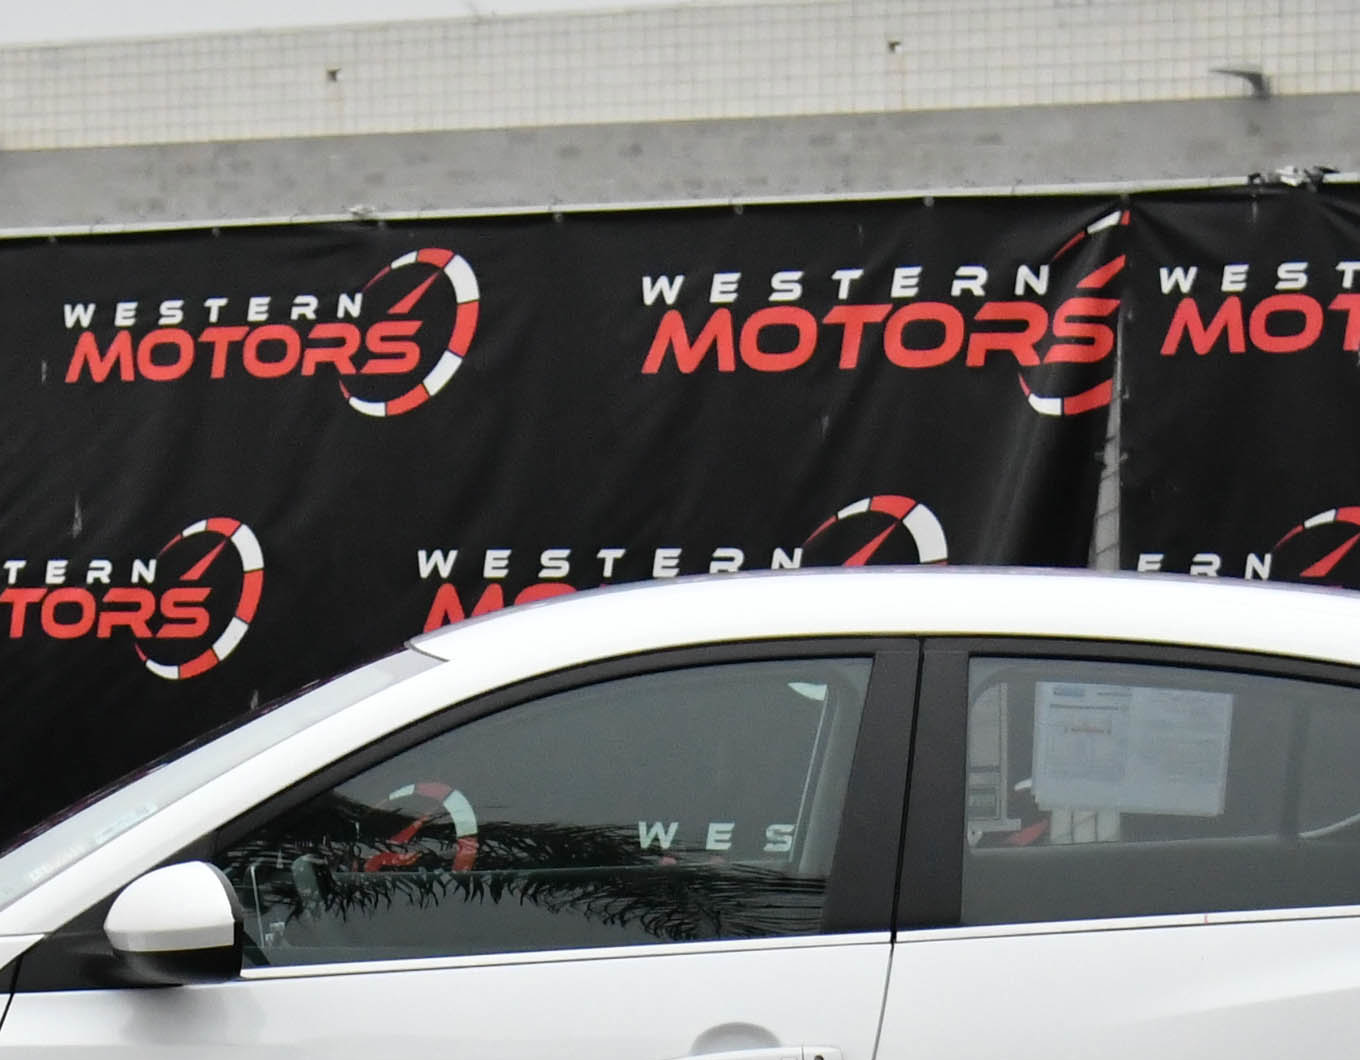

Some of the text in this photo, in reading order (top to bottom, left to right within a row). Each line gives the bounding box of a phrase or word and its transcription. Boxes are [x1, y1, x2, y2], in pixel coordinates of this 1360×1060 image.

[642, 264, 1050, 306] WESTERN
[64, 293, 363, 328] WESTERN
[65, 321, 423, 383] MOTORS
[641, 297, 1121, 374] MOTORS
[417, 548, 803, 579] WESTERN
